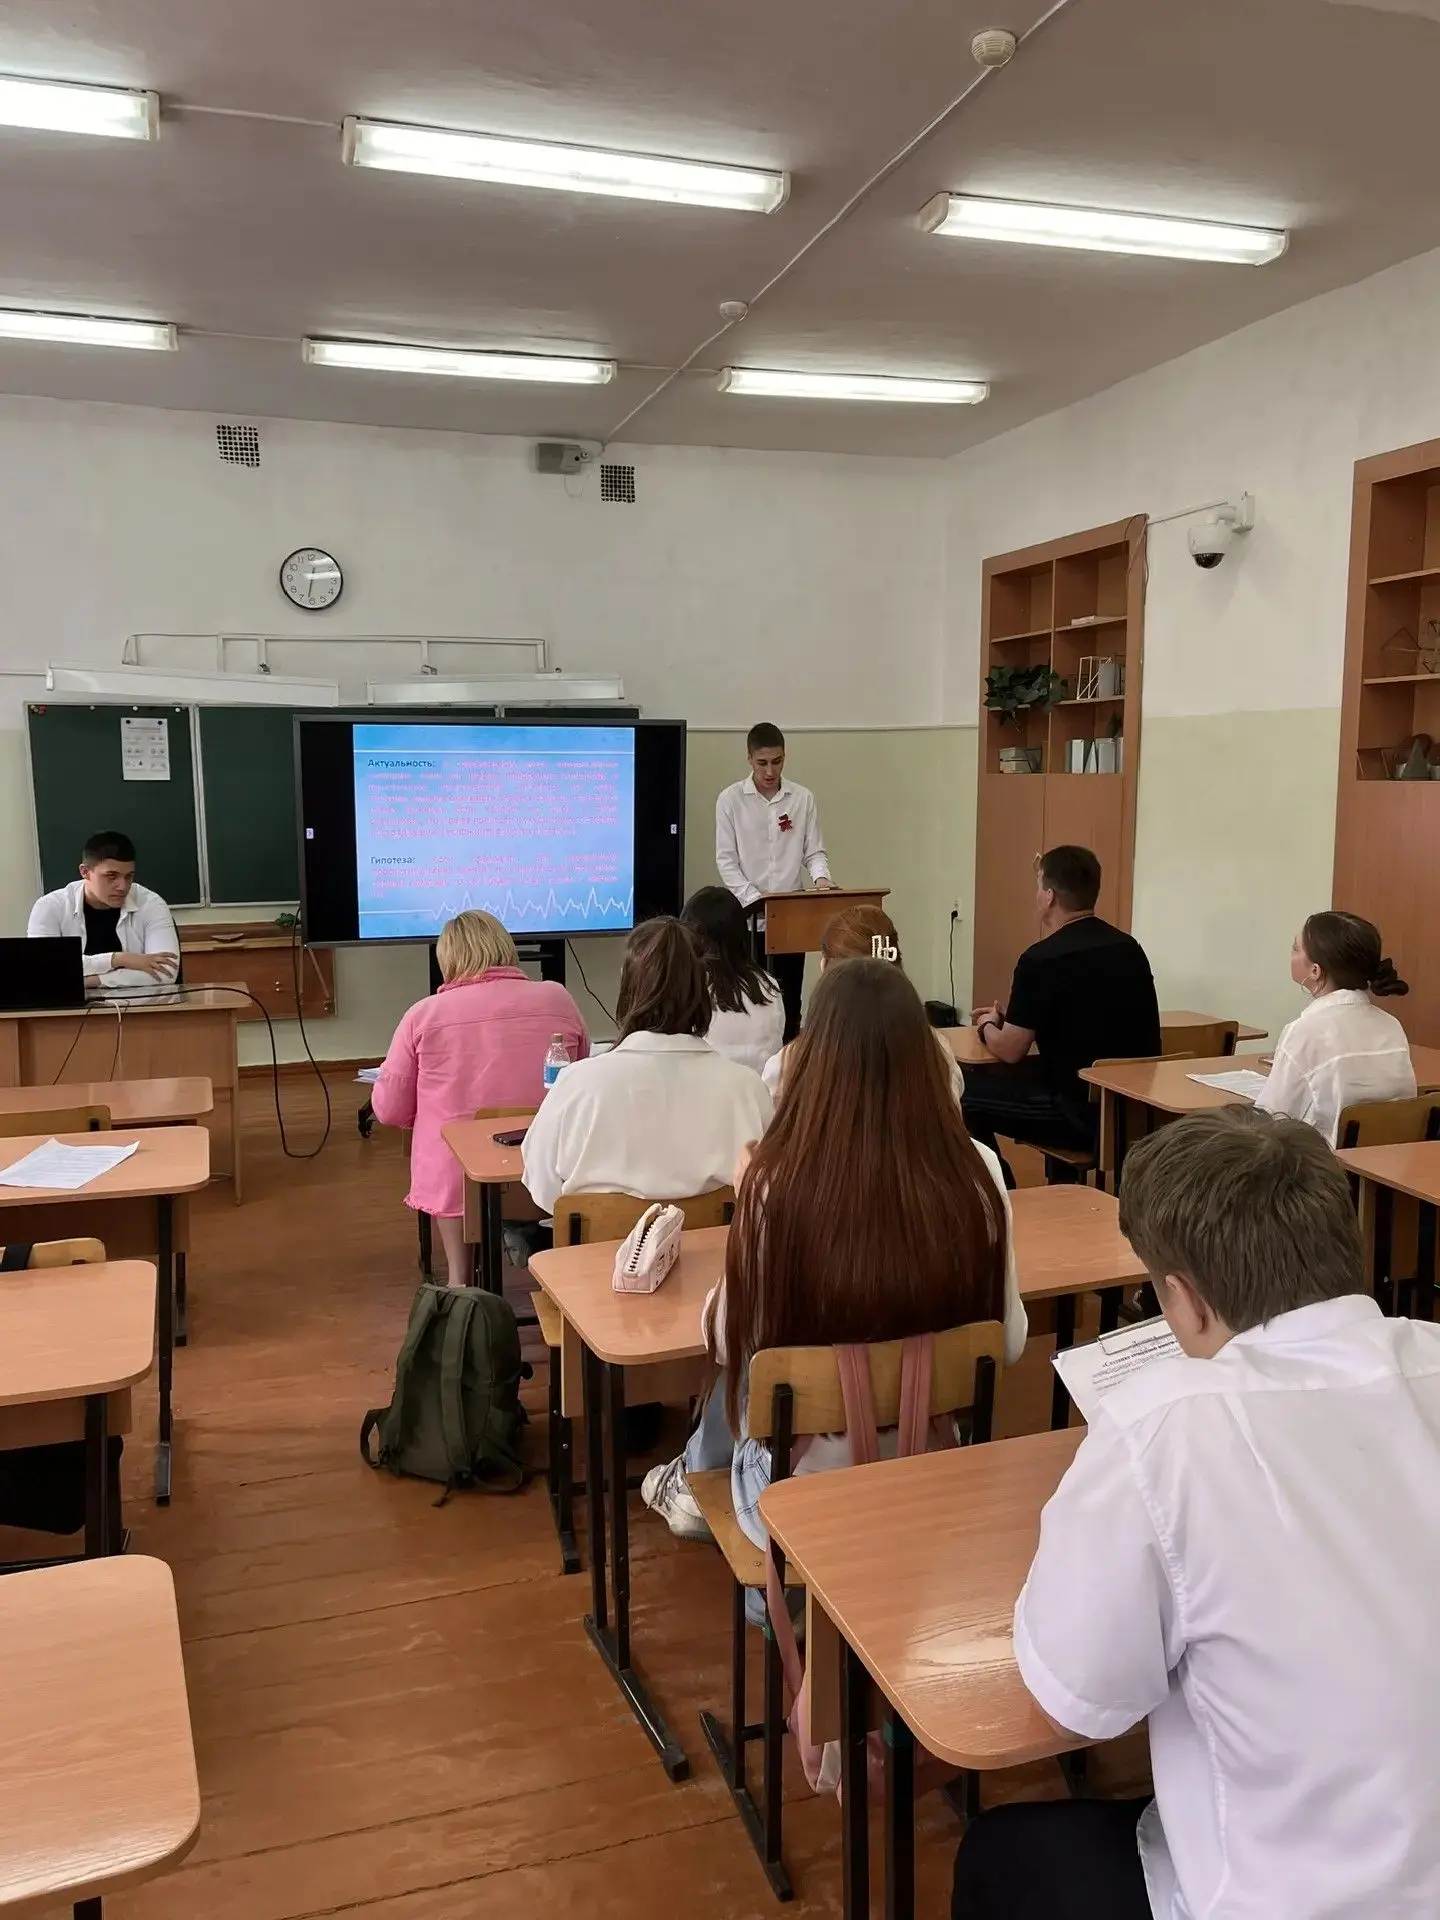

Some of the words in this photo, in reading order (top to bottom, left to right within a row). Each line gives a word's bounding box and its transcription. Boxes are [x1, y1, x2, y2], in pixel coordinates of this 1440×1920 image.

[290, 563, 298, 571] 10
[286, 574, 293, 582] 9
[330, 577, 337, 585] 3
[290, 585, 297, 594] 8
[328, 587, 334, 595] 4
[309, 597, 316, 605] 6
[319, 595, 327, 603] 5
[367, 759, 436, 769] Актуальность:
[370, 856, 416, 865] Гипотеза:
